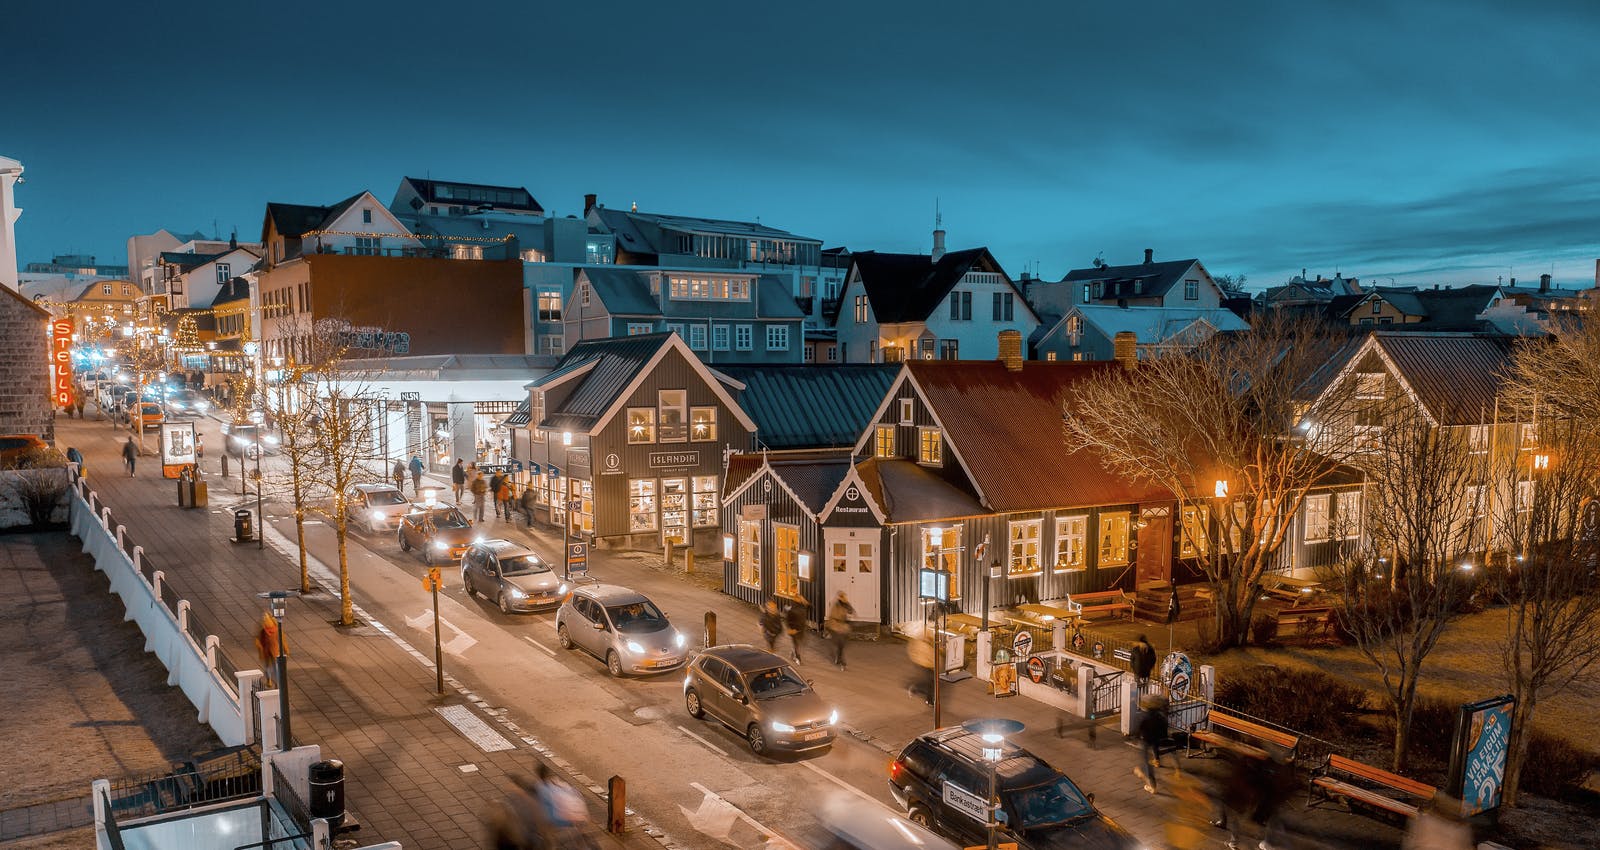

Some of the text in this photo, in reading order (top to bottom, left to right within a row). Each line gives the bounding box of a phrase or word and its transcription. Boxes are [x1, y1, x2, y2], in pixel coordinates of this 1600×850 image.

[55, 322, 70, 403] STELLA
[401, 392, 419, 401] NLSN
[488, 466, 507, 474] NLN
[1479, 722, 1503, 760] EIGUM
[950, 790, 983, 815] Bankastræti
